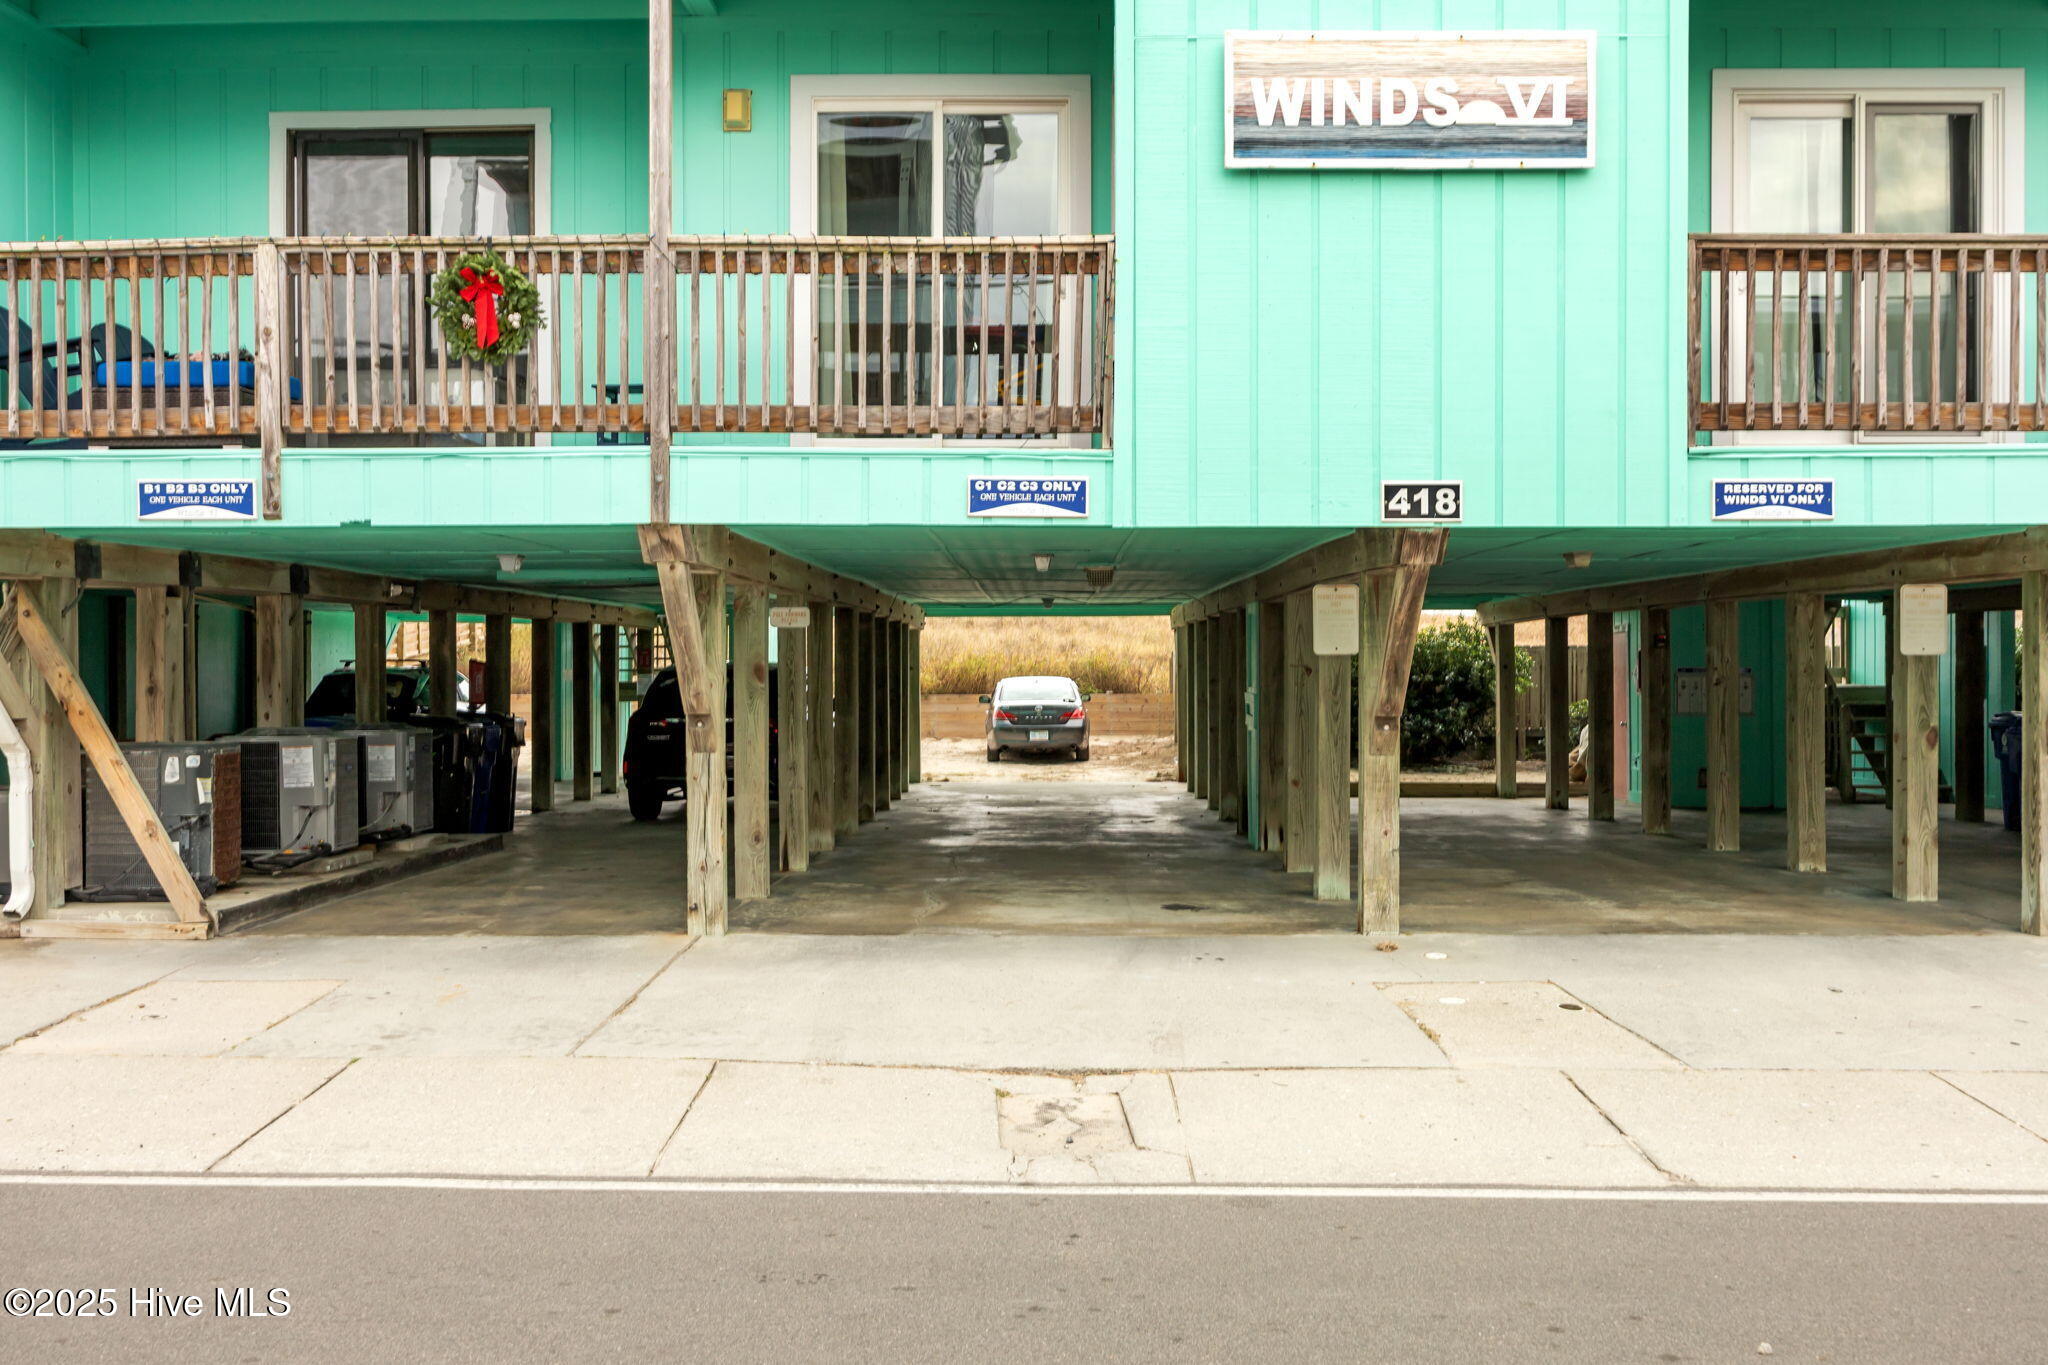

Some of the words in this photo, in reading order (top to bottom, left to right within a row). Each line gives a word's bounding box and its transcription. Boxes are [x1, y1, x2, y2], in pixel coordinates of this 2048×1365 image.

[1250, 77, 1460, 127] WINDS
[1495, 76, 1574, 126] VI
[144, 483, 160, 494] B1
[166, 483, 184, 494] B2
[188, 483, 206, 494] B3
[210, 483, 249, 494] ONLY
[975, 480, 992, 491] C1
[997, 480, 1016, 491] C2
[1020, 480, 1038, 491] C3
[1042, 480, 1081, 491] ONLY
[1724, 484, 1794, 494] RESERVED
[1797, 484, 1824, 493] FOR
[149, 496, 166, 504] ONE
[168, 496, 200, 504] VEHICLE
[202, 496, 223, 504] EACH
[225, 496, 244, 504] UNIT
[980, 493, 997, 501] ONE
[999, 493, 1031, 502] VEHICLE
[1034, 494, 1055, 502] EACH
[1057, 494, 1077, 502] UNIT
[1388, 487, 1457, 516] 418
[1724, 495, 1767, 505] WINDS
[1770, 495, 1785, 505] VI
[1788, 495, 1825, 505] ONLY
